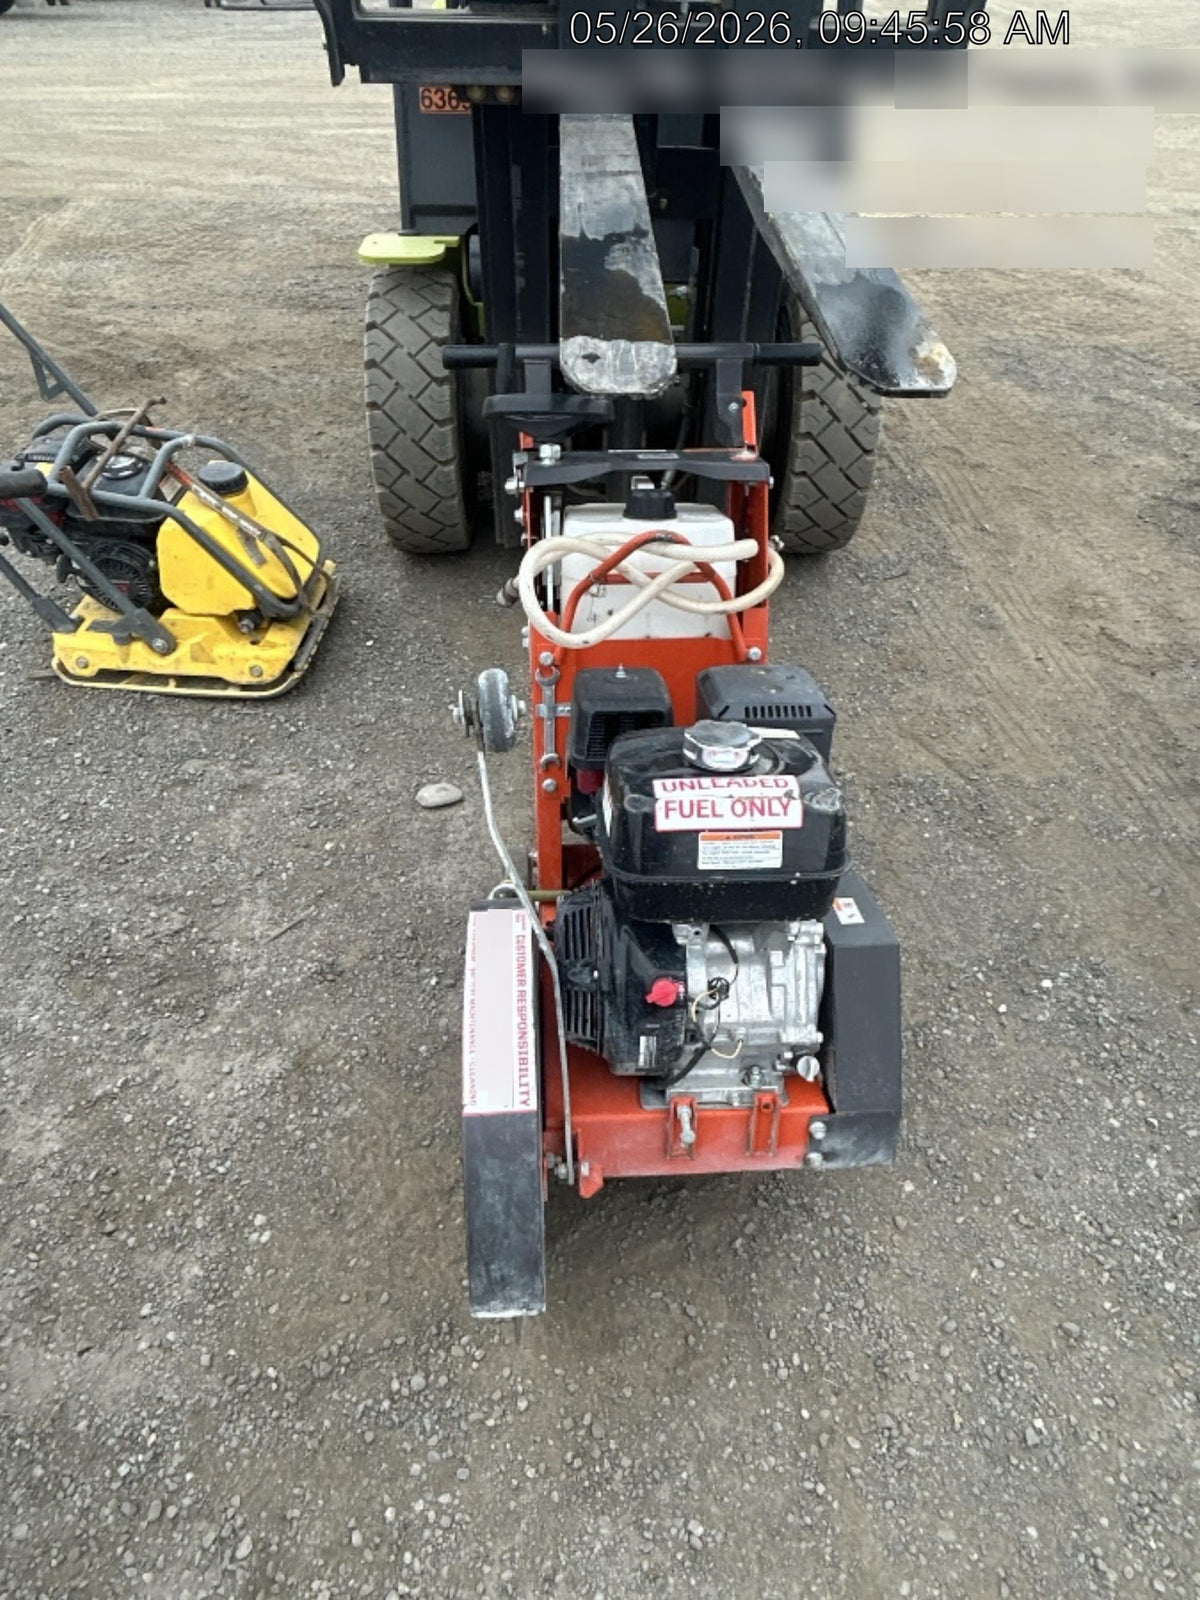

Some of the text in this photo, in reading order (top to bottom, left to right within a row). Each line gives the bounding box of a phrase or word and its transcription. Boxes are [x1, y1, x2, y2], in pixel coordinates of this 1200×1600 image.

[661, 778, 790, 793] UNLEADED
[664, 797, 792, 820] FUEL ONLY
[516, 934, 527, 987] CUSTOMER
[517, 990, 531, 1106] RESPONSIBILITY
